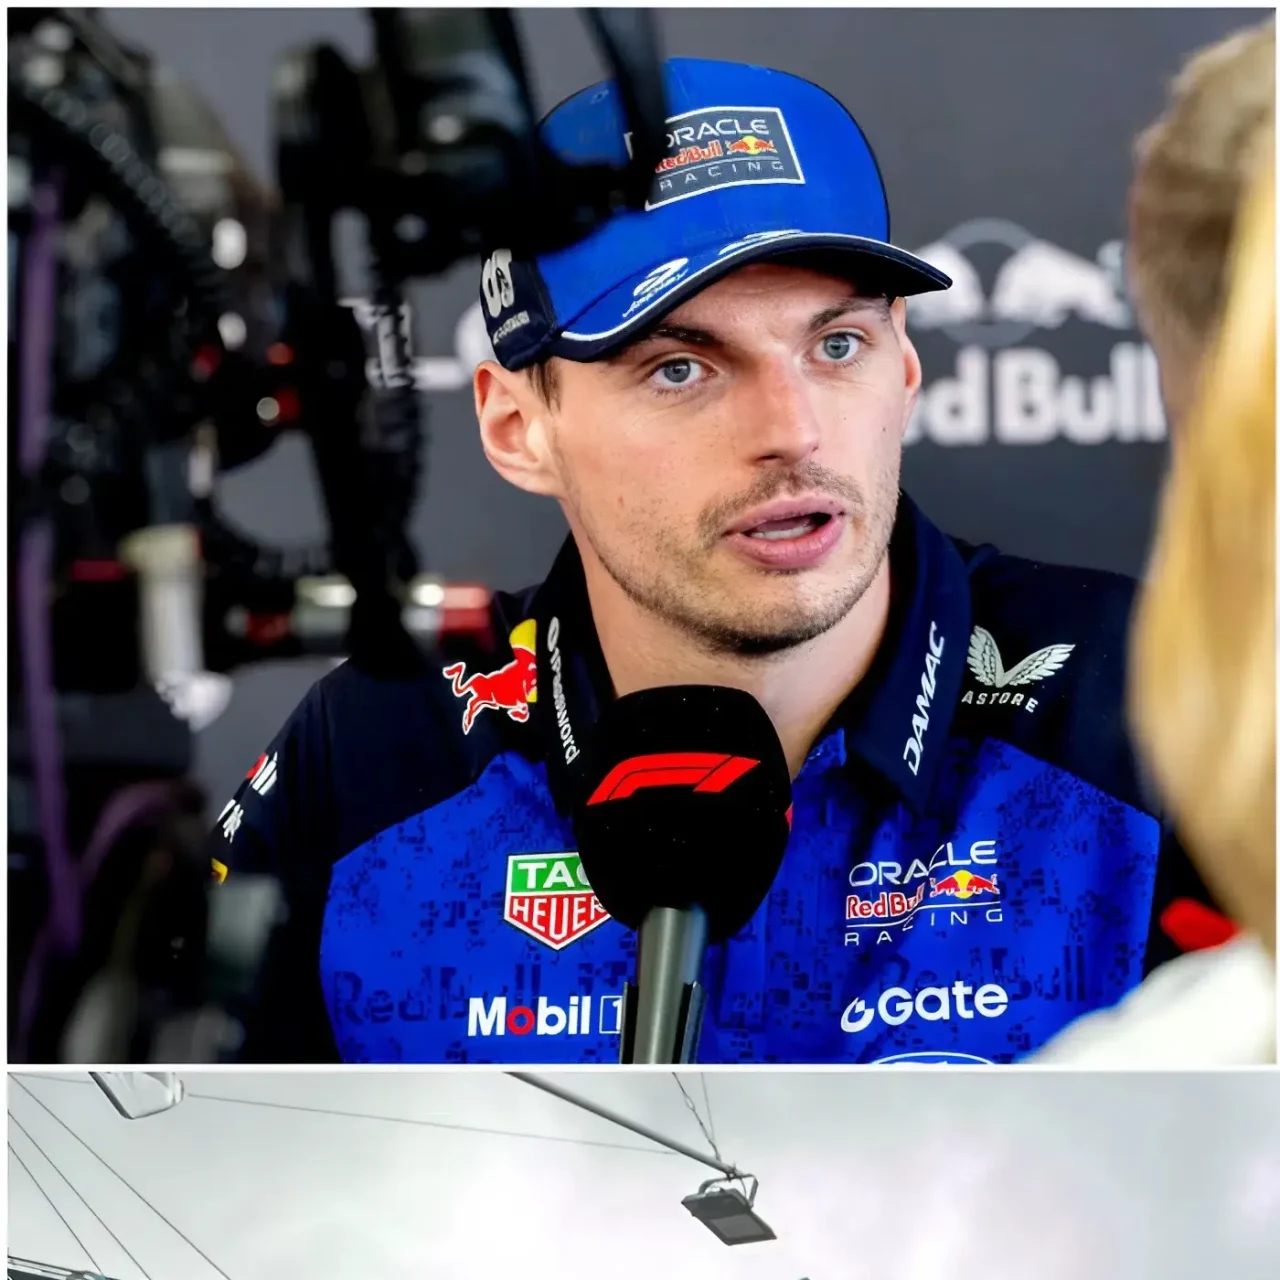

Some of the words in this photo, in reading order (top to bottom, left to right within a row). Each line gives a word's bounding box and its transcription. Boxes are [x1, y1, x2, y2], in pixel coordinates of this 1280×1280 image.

[660, 161, 784, 191] RACING
[903, 621, 945, 776] DAMAC
[961, 690, 1039, 713] ASTORE
[849, 840, 998, 887] ORACLE
[844, 908, 1003, 946] RACING
[467, 995, 591, 1036] Mobil
[878, 980, 1008, 1026] Gate
